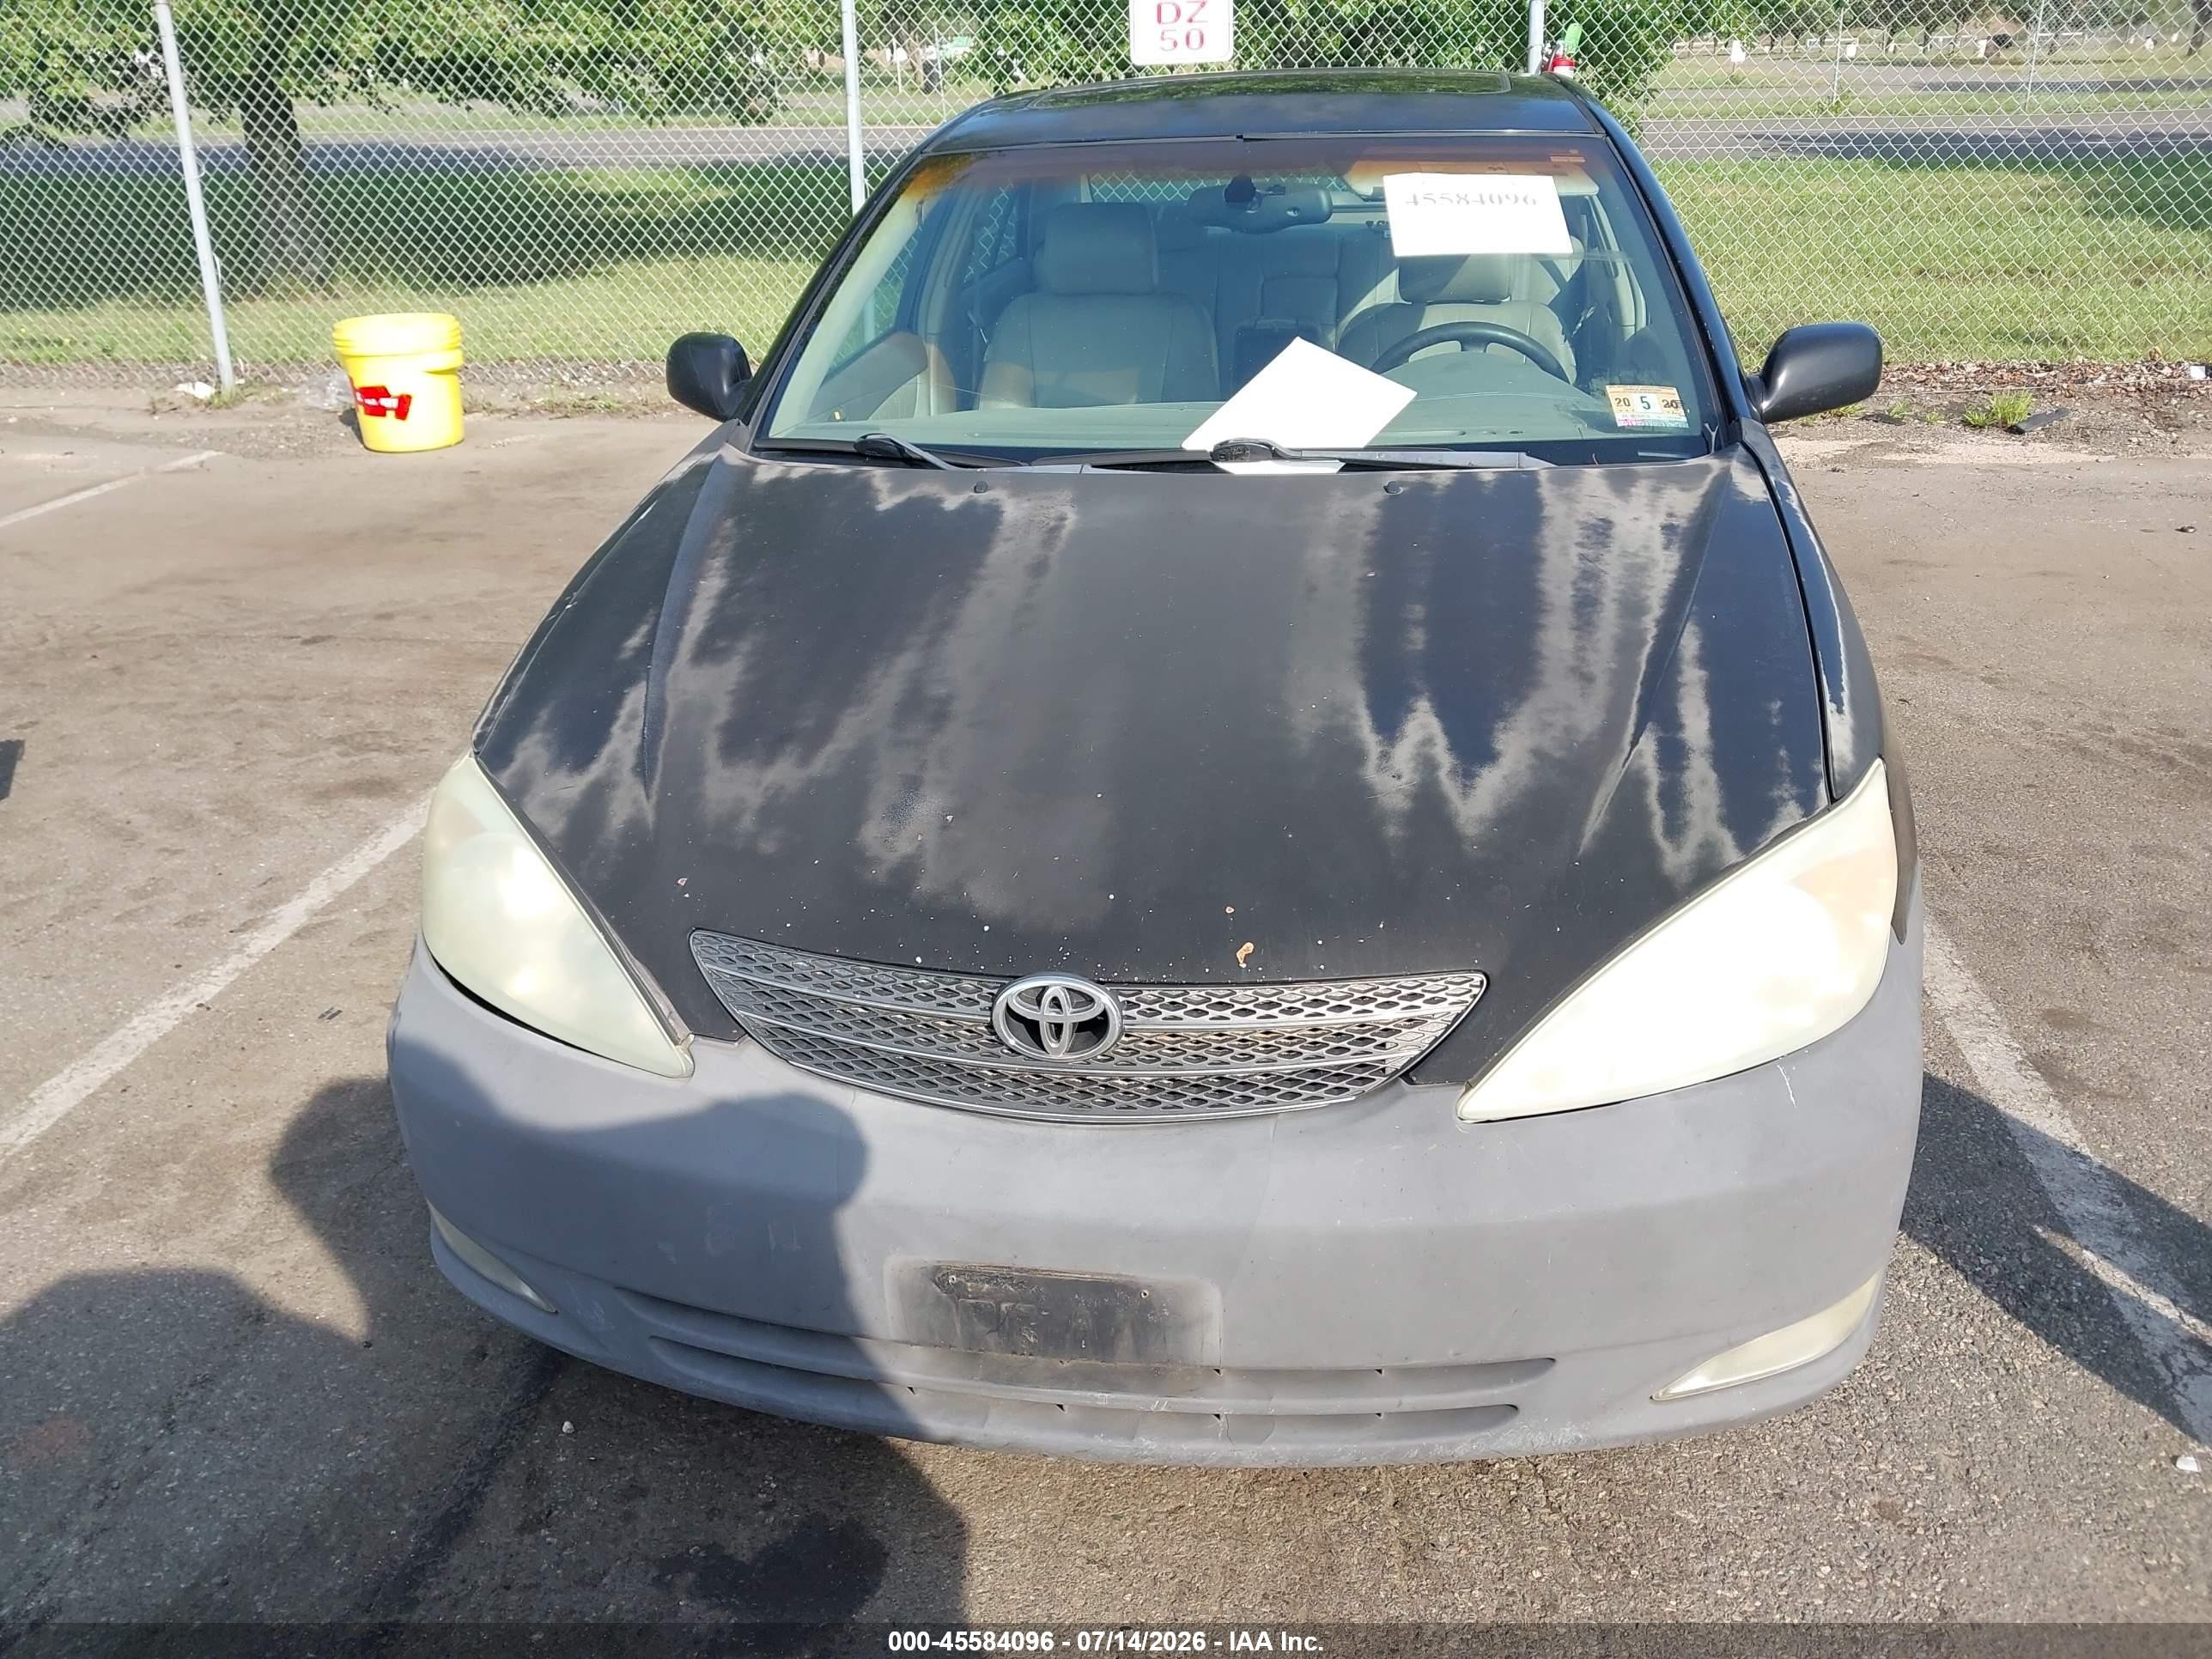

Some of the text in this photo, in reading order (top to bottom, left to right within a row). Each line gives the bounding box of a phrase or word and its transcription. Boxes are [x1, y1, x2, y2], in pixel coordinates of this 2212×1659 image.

[1157, 1, 1209, 24] DZ
[1161, 28, 1205, 52] 50
[1614, 398, 1631, 407] 20
[1640, 396, 1650, 410] 5
